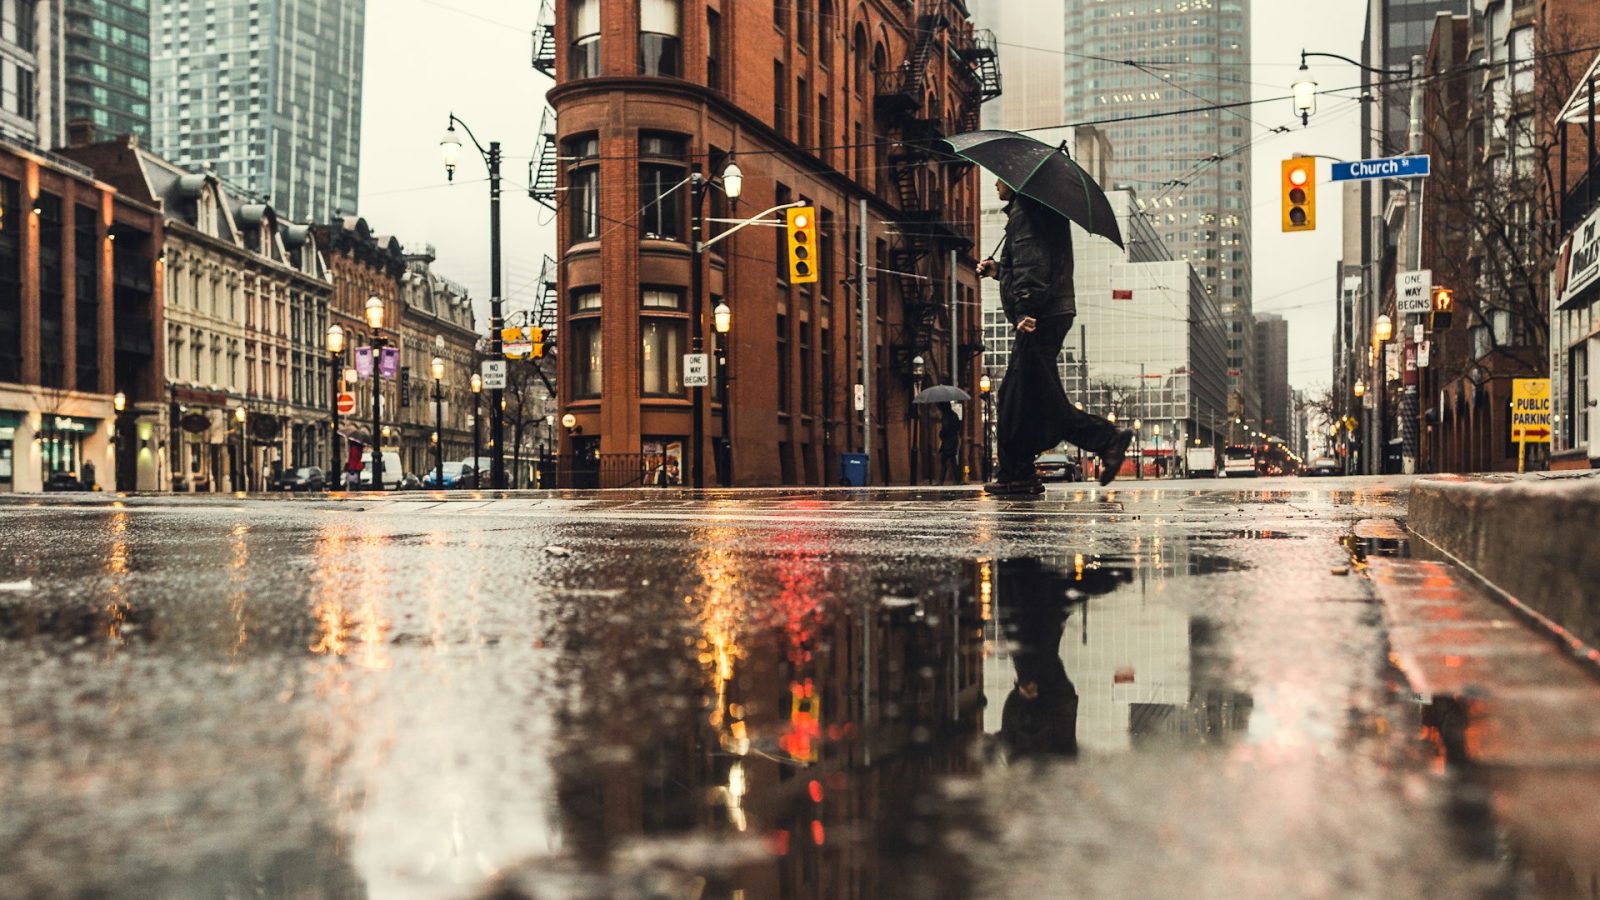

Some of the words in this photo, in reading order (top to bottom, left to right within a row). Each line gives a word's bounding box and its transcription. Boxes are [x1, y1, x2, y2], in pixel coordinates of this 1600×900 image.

[1350, 160, 1399, 176] Church
[1404, 275, 1422, 285] ONE
[1405, 287, 1422, 297] WAY
[1398, 299, 1430, 310] BEGINS
[690, 356, 702, 364] ONE
[489, 364, 499, 372] NO
[685, 376, 706, 384] BEGINS
[1517, 398, 1550, 410] PUBLIC
